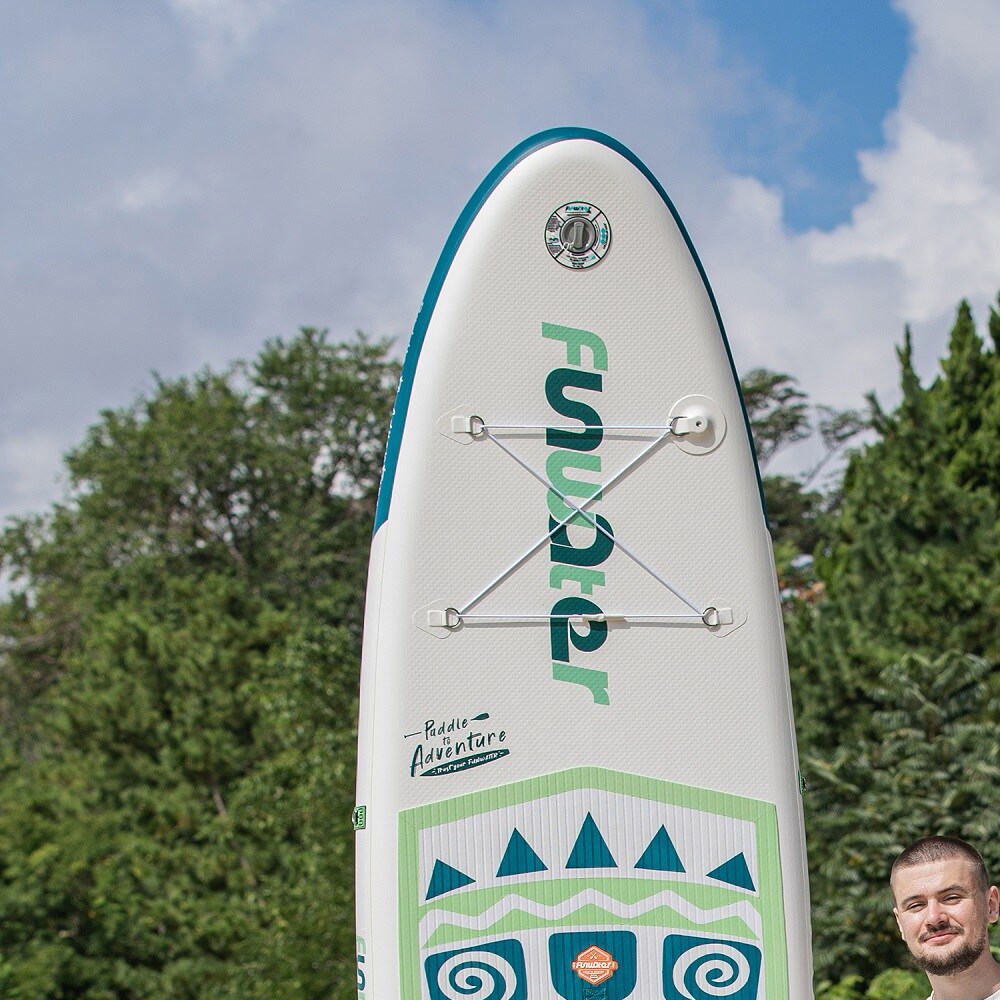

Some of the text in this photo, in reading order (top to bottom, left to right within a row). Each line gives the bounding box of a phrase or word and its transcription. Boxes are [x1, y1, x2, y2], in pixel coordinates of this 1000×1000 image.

[424, 718, 469, 741] Paddle
[443, 736, 451, 745] to
[410, 730, 507, 777] Adventure
